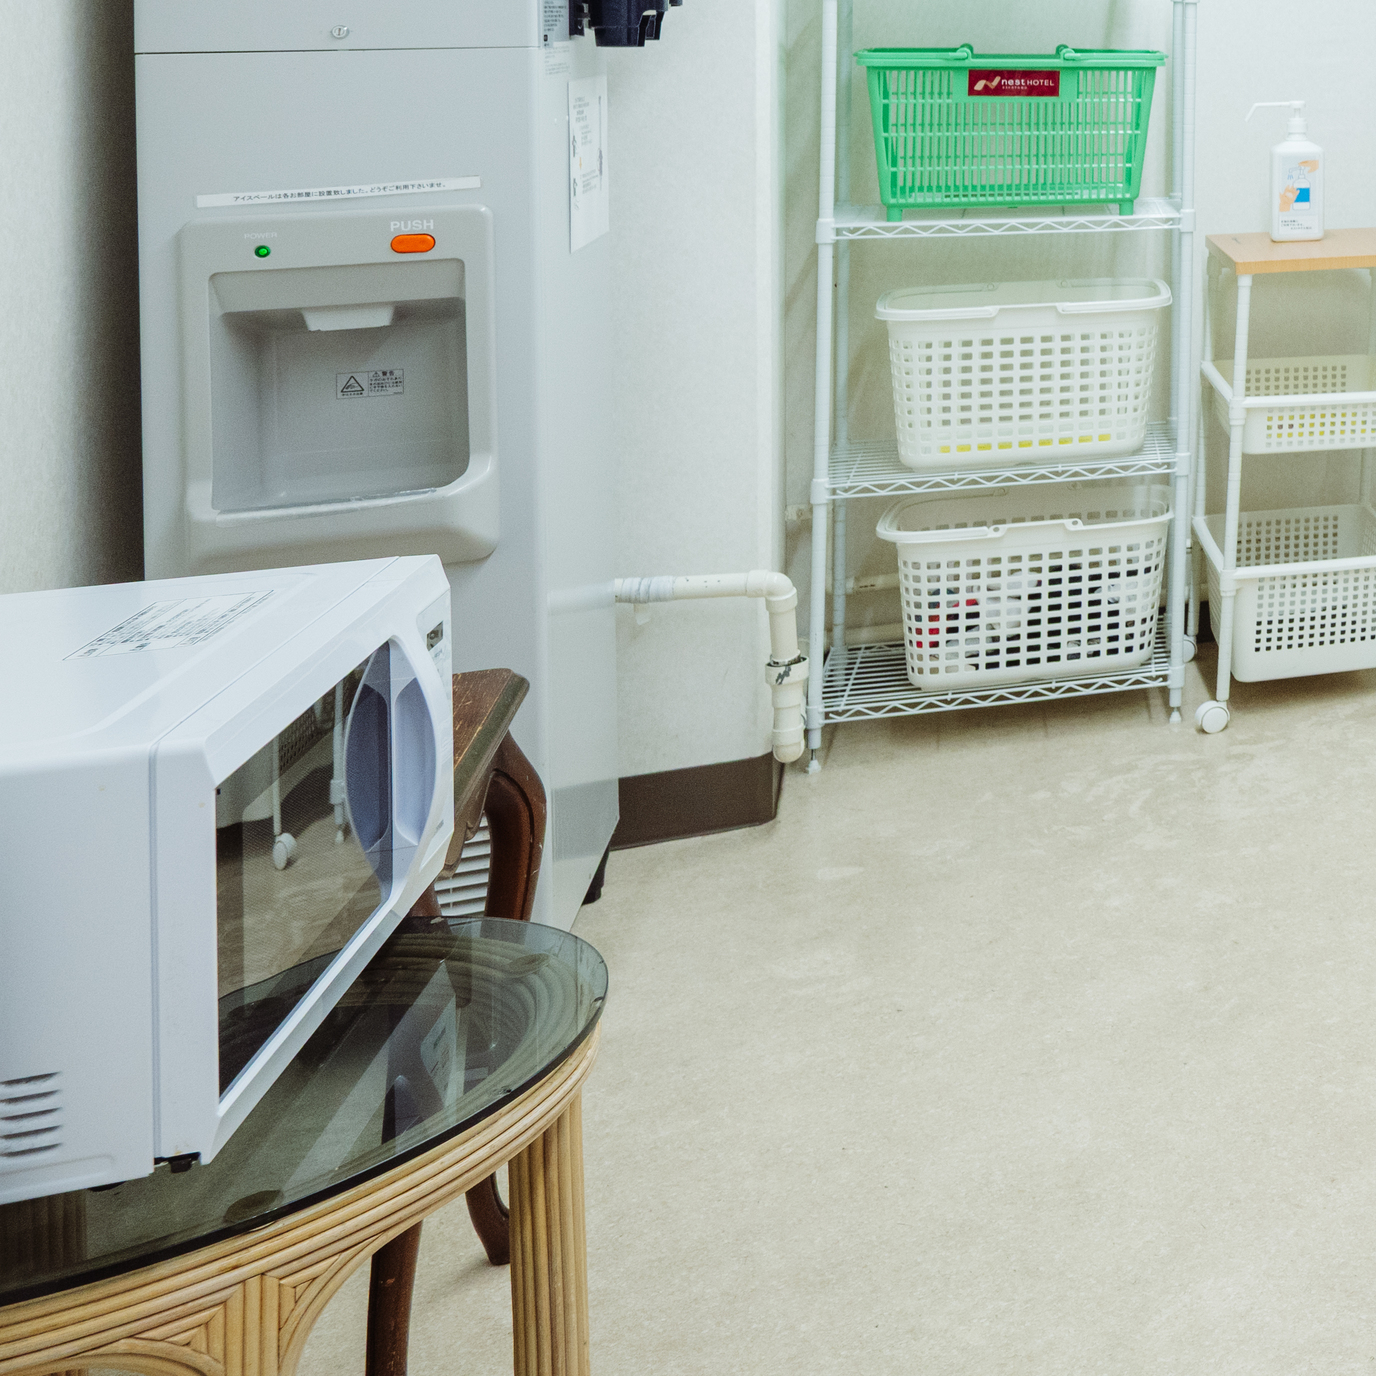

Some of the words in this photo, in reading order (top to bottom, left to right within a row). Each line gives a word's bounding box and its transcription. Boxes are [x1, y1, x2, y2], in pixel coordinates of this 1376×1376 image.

[1026, 79, 1055, 87] HOTEL
[390, 219, 435, 233] PUSH
[244, 231, 278, 241] POWER
